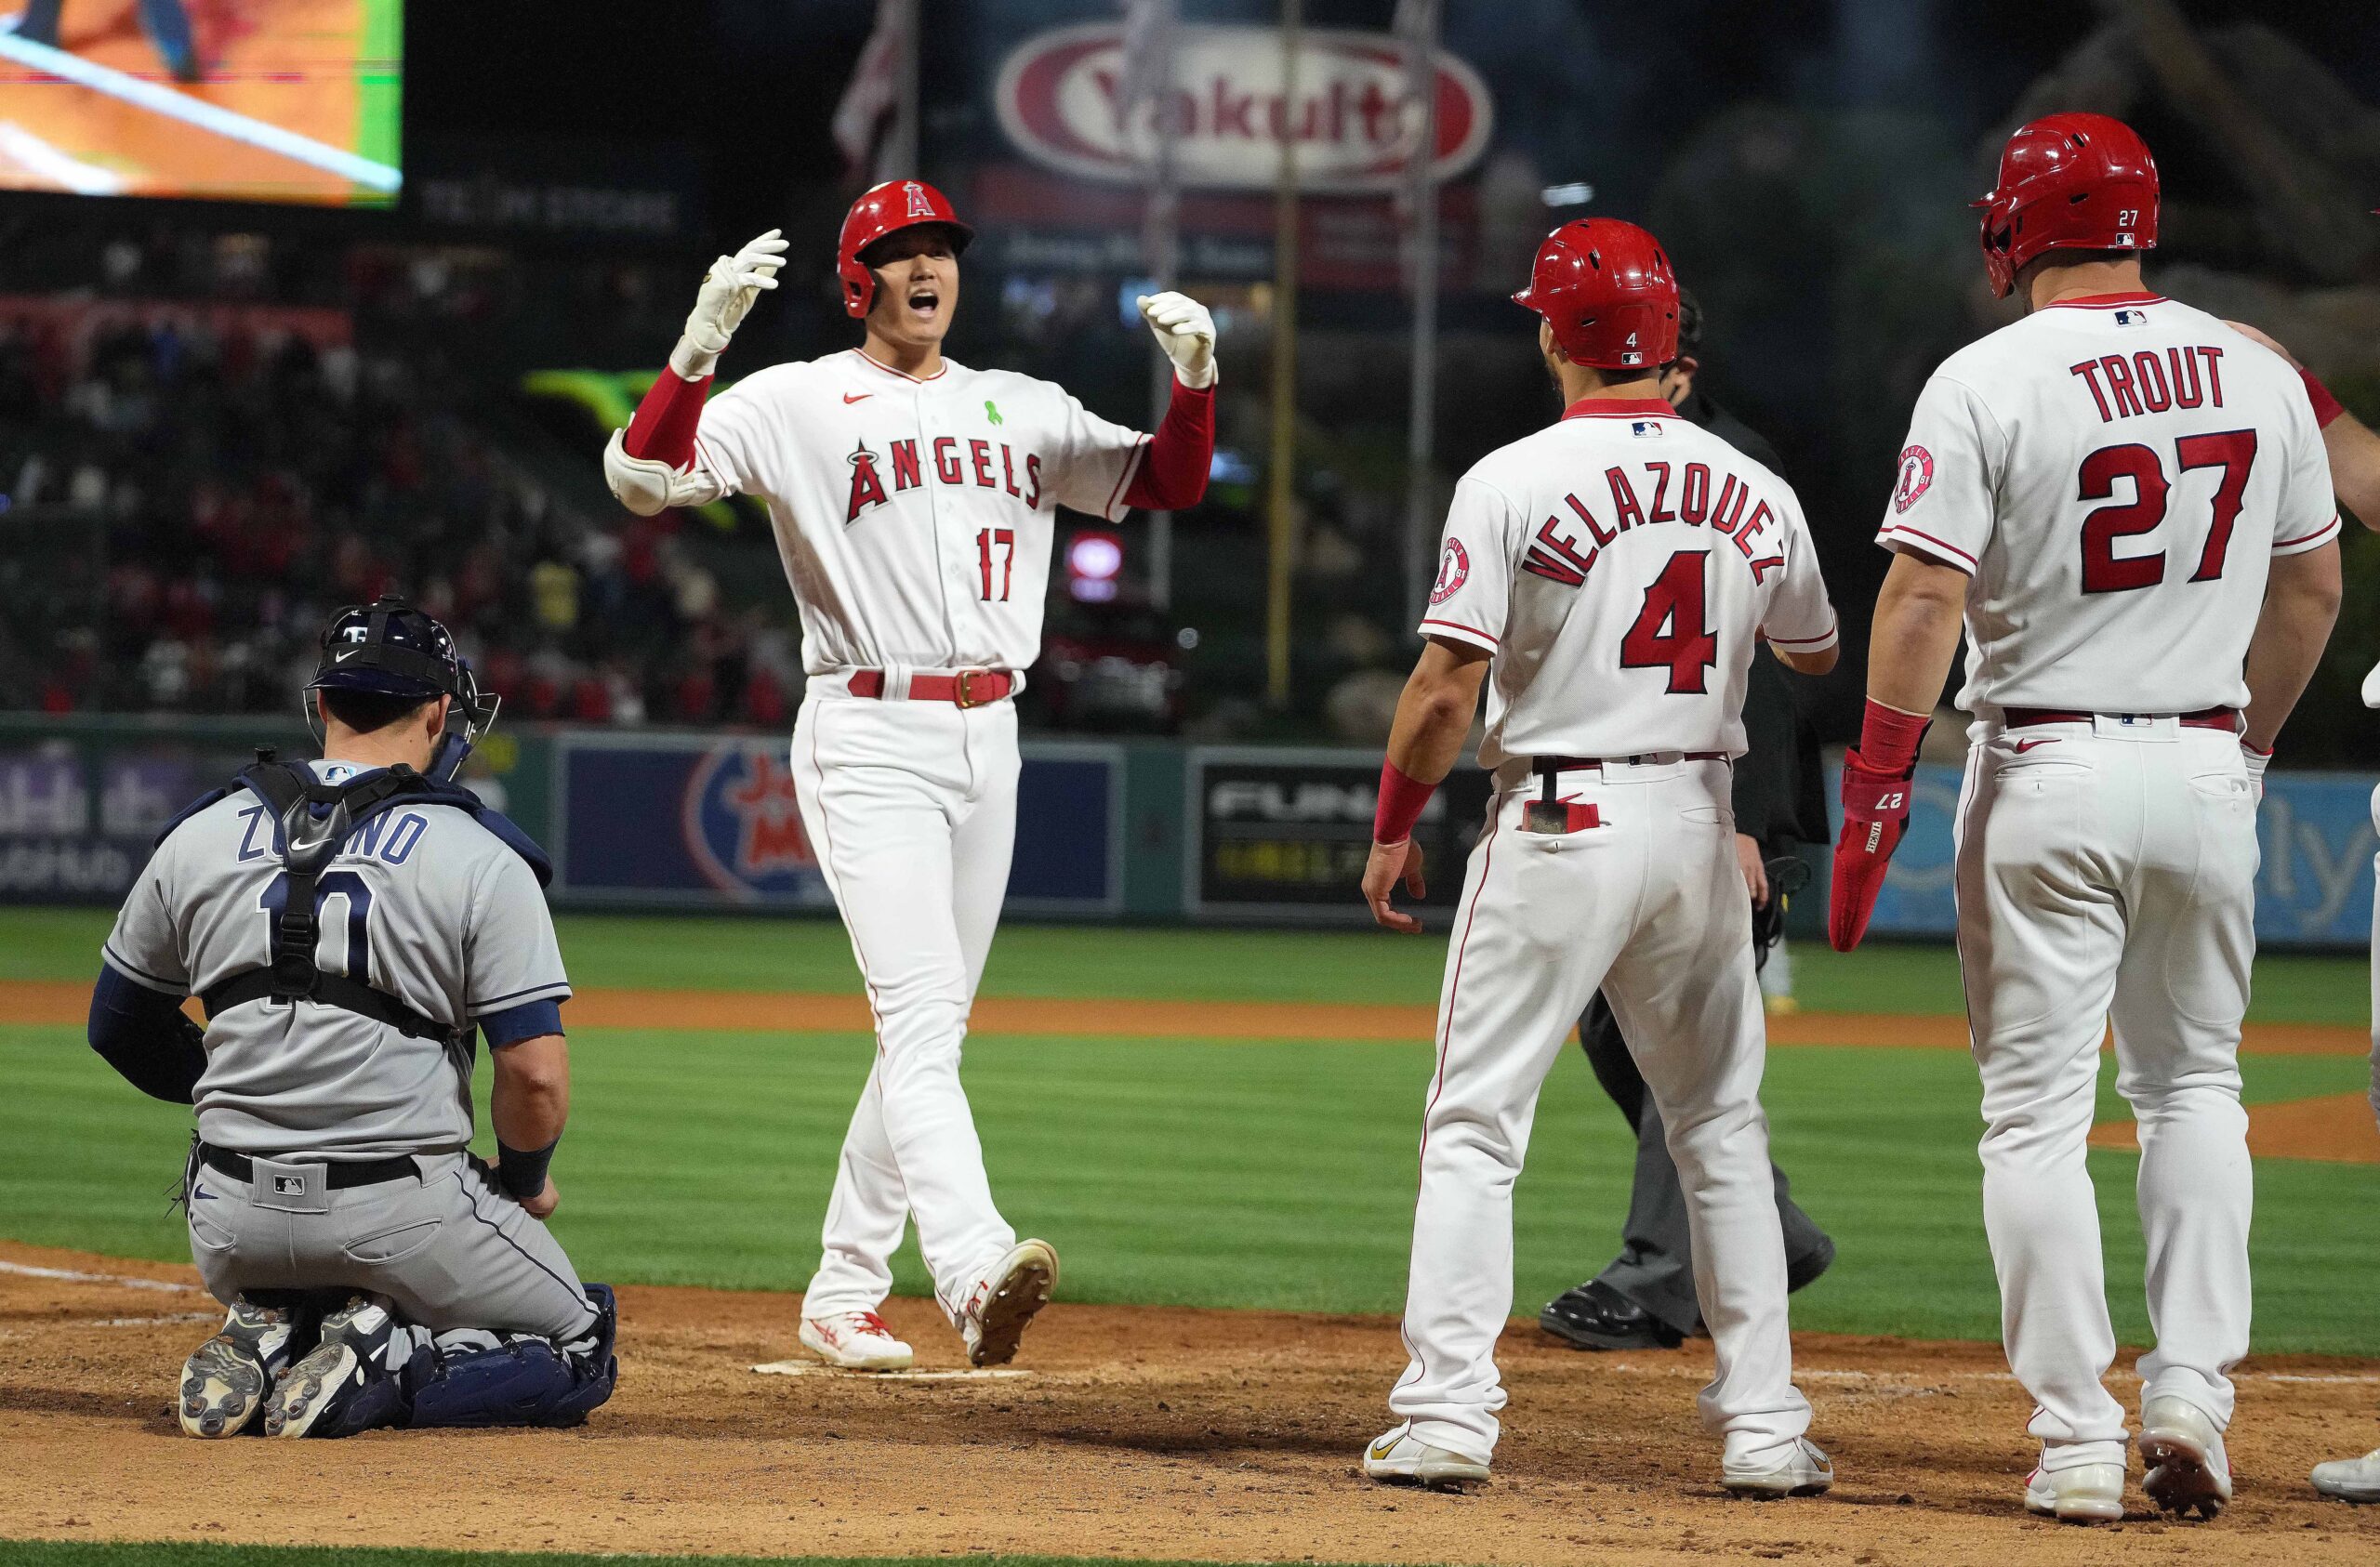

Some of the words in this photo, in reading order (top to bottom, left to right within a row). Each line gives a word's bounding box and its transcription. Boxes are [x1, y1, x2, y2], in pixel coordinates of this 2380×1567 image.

[903, 181, 935, 217] A
[2119, 210, 2138, 227] 27
[1626, 332, 1637, 348] 4
[2069, 346, 2224, 423] TROUT
[845, 438, 1041, 526] ANGELS
[2077, 428, 2257, 595] 27
[1522, 461, 1785, 587] VELAZQUEZ
[976, 528, 1014, 602] 17
[1620, 550, 1717, 695] 4
[236, 804, 430, 867] ZNO
[1874, 792, 1903, 810] 27
